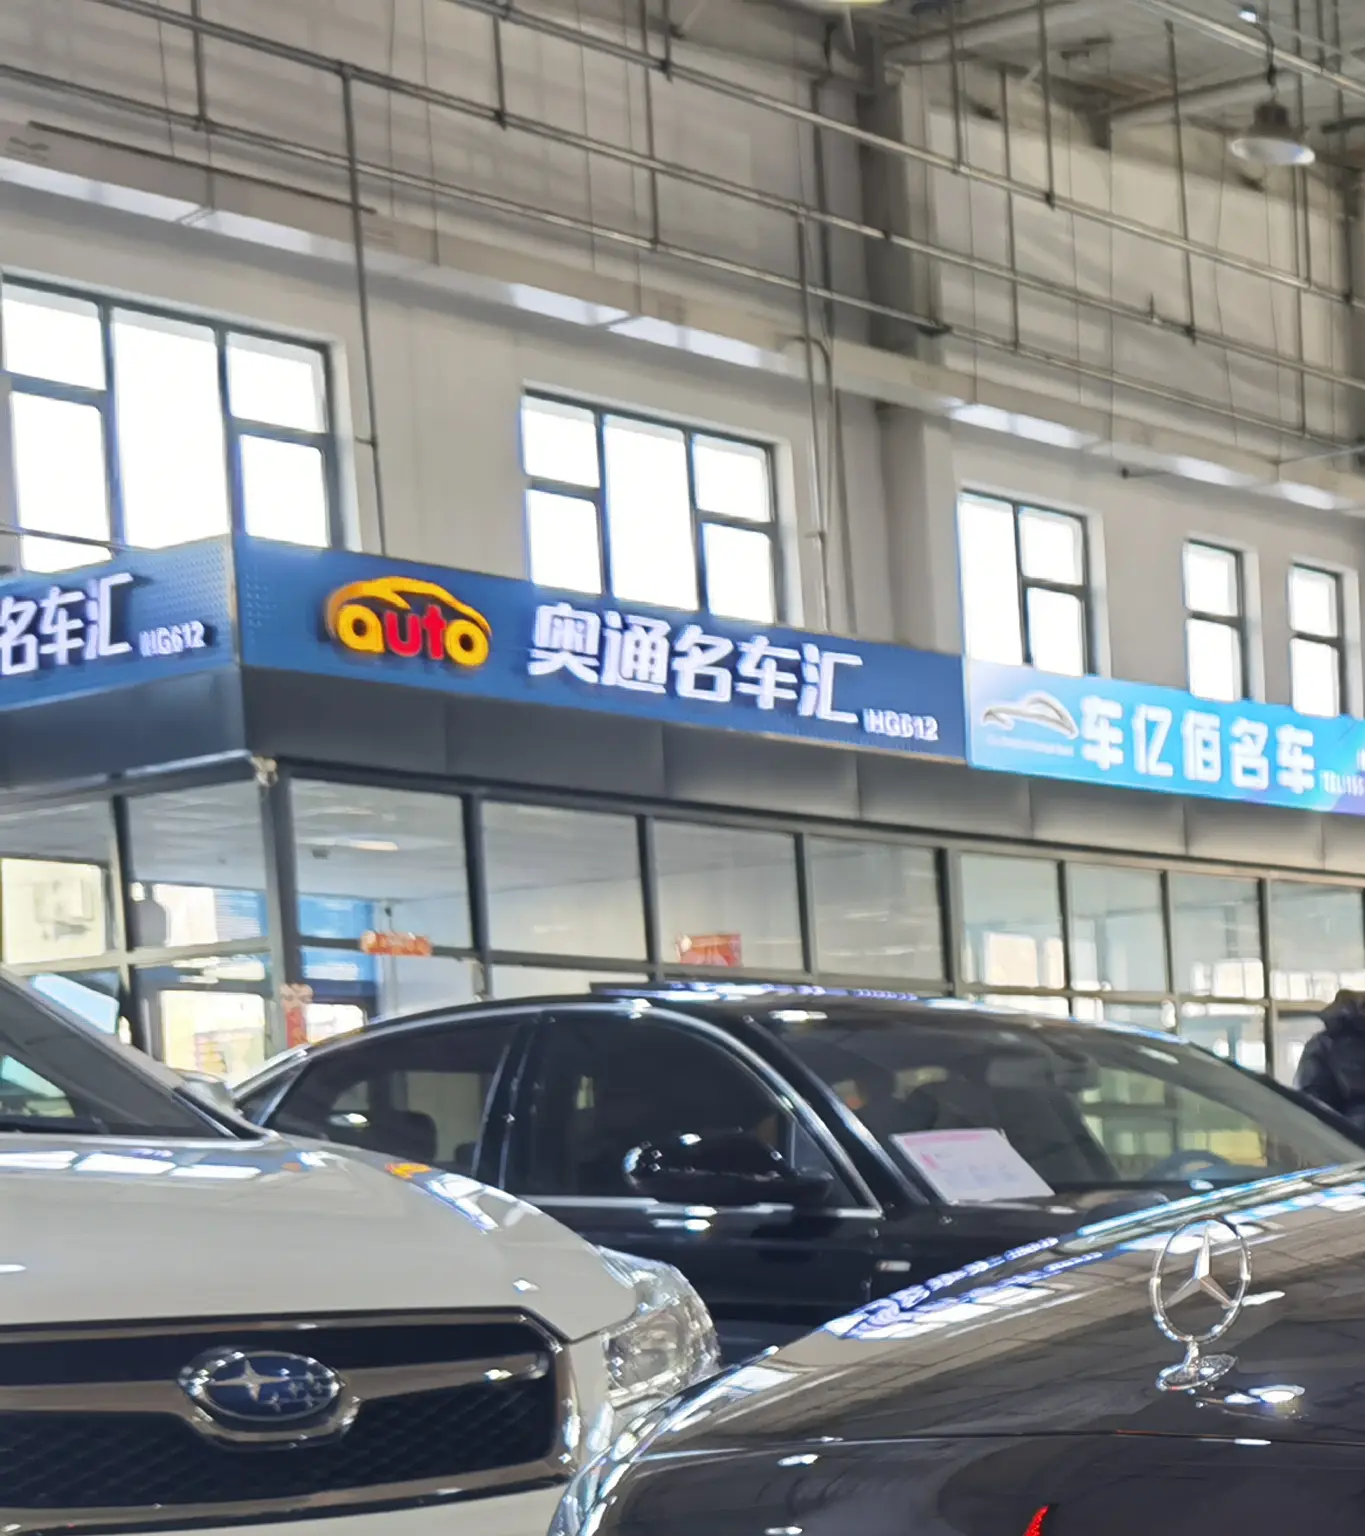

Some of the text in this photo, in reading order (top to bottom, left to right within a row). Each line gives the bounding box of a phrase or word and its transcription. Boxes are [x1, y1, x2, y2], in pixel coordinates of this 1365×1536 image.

[337, 604, 490, 668] auto
[528, 601, 864, 725] 奥通名车汇
[1079, 694, 1316, 795] 车亿佰名车
